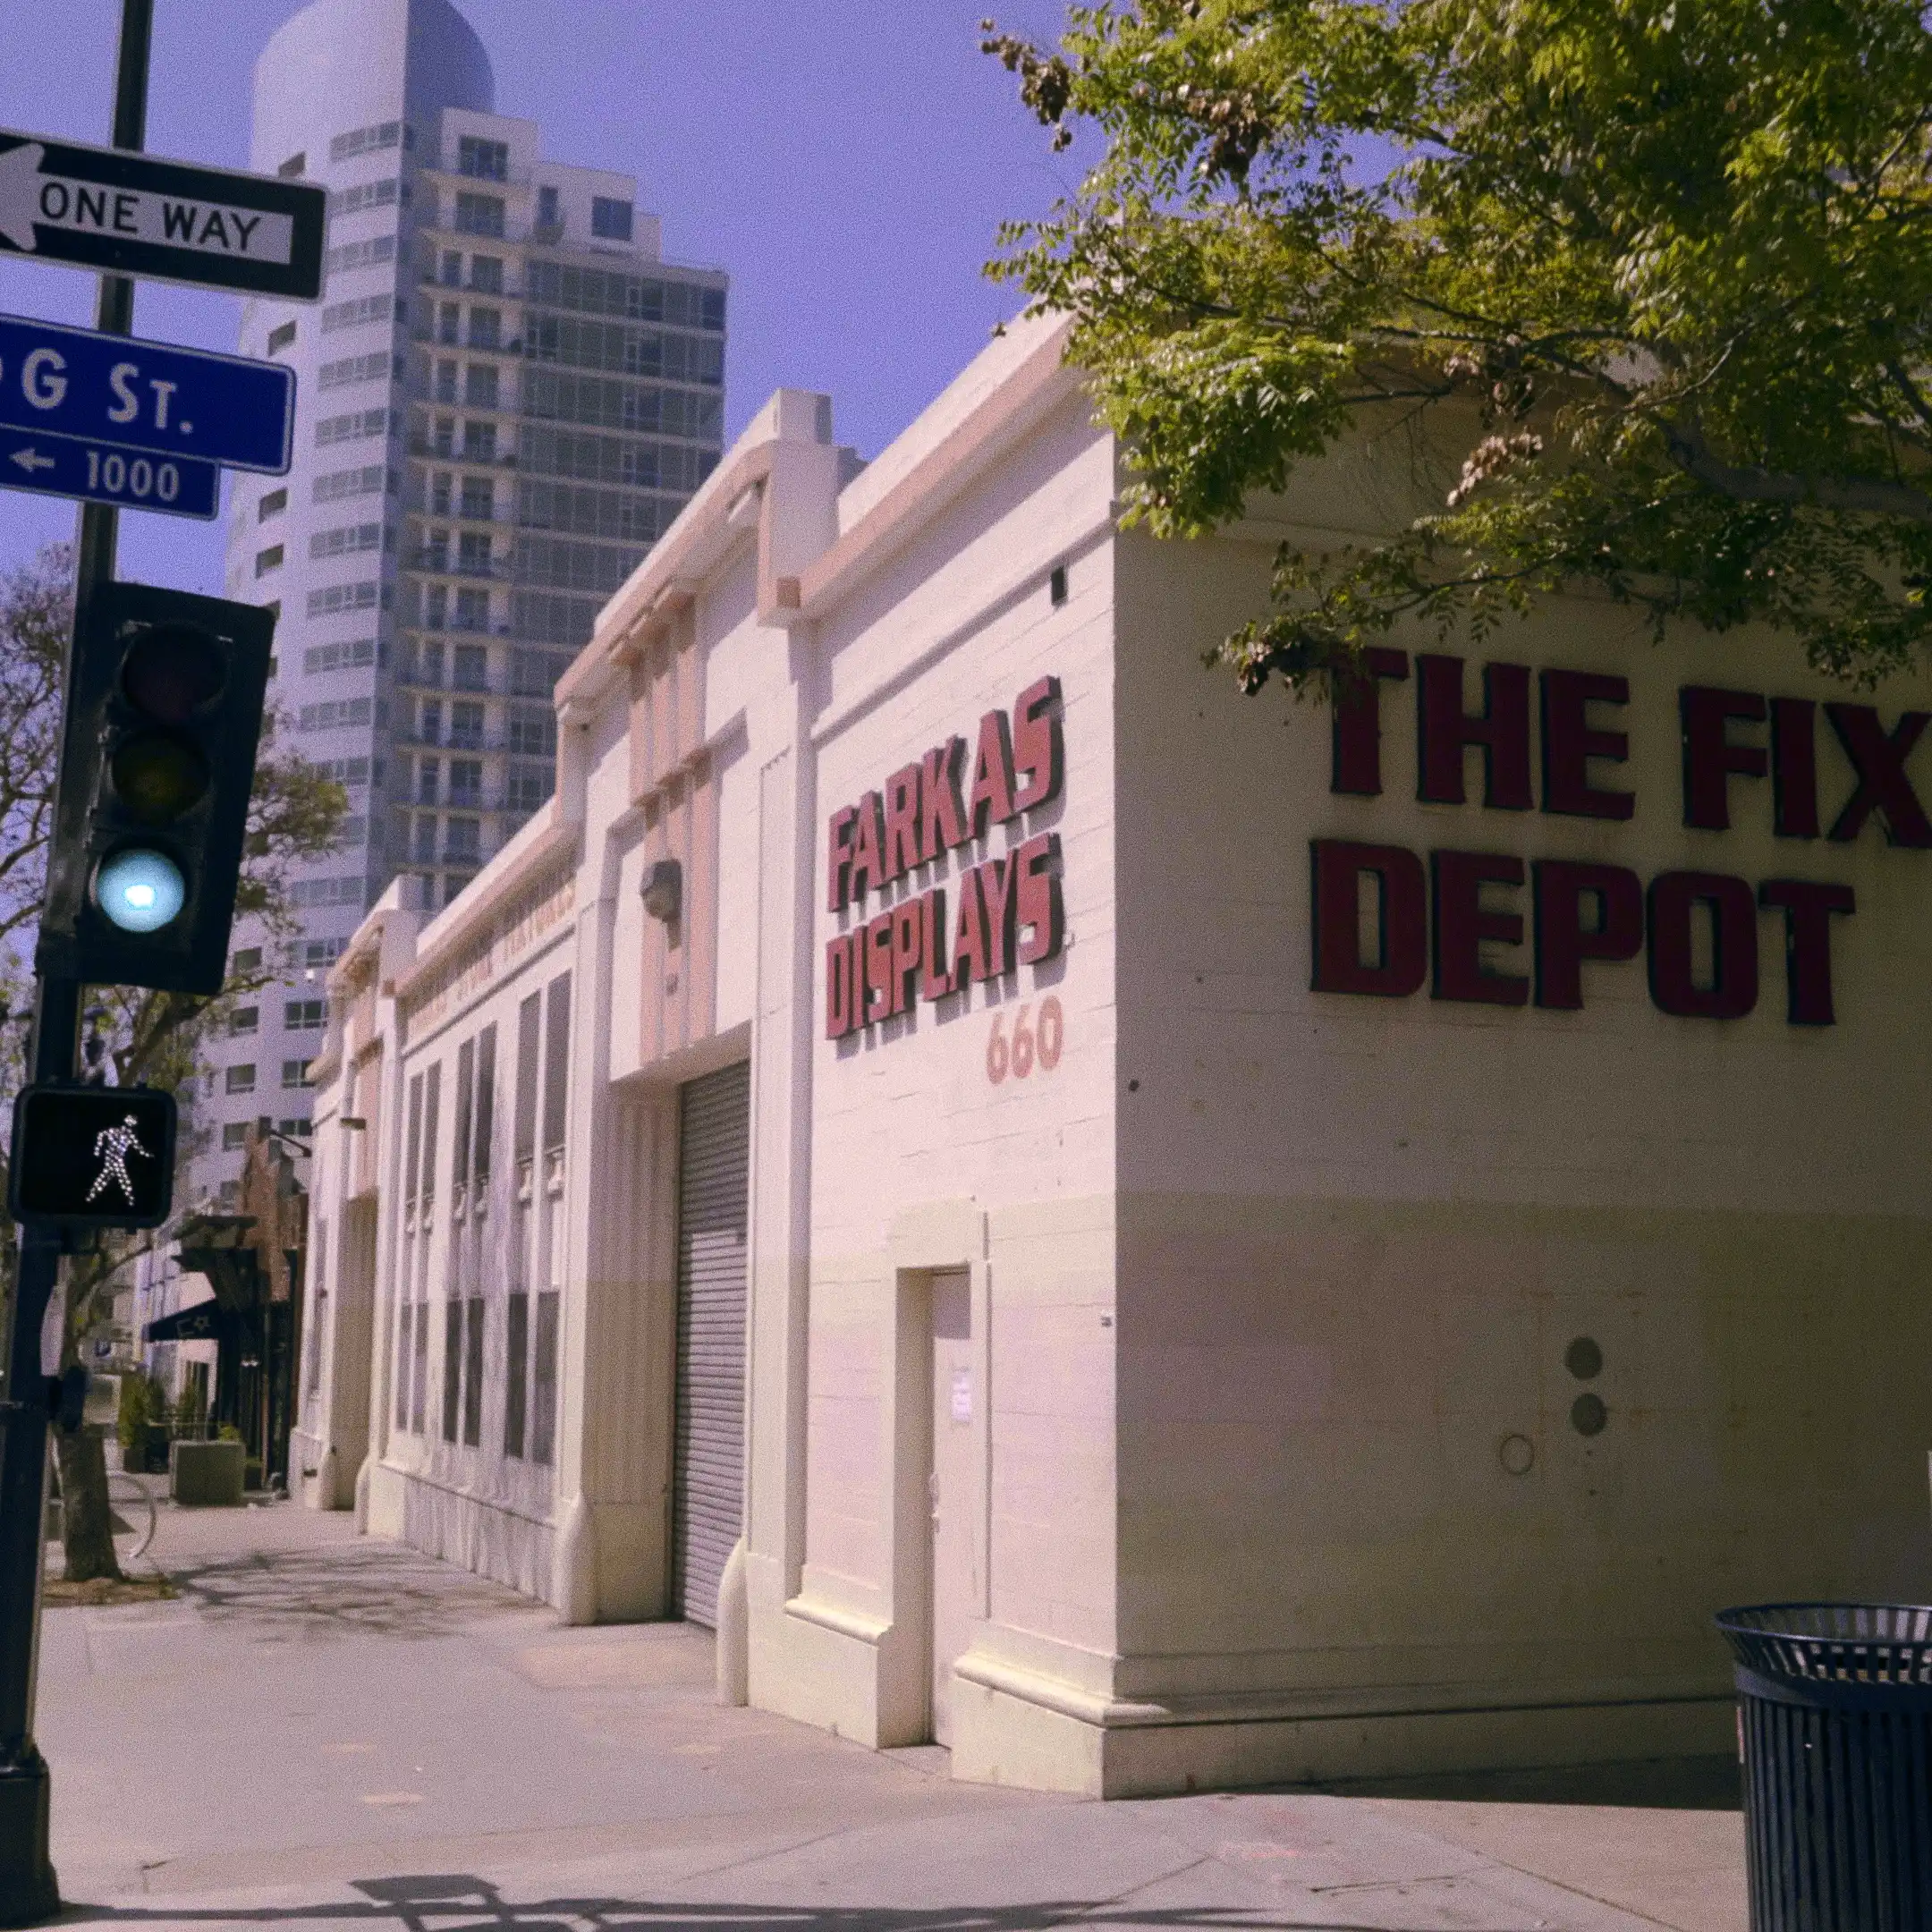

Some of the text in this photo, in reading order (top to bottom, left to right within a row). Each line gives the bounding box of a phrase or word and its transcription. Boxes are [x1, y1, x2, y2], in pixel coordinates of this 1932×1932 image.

[40, 182, 261, 251] ONE WAY
[21, 348, 193, 435] G ST.
[88, 451, 179, 501] 1000
[827, 675, 1063, 913] FARKAS
[1318, 646, 1932, 848] THE FIX
[826, 832, 1063, 1040] DISPLAYS
[1309, 838, 1856, 1026] DEPOT
[987, 995, 1063, 1084] 660
